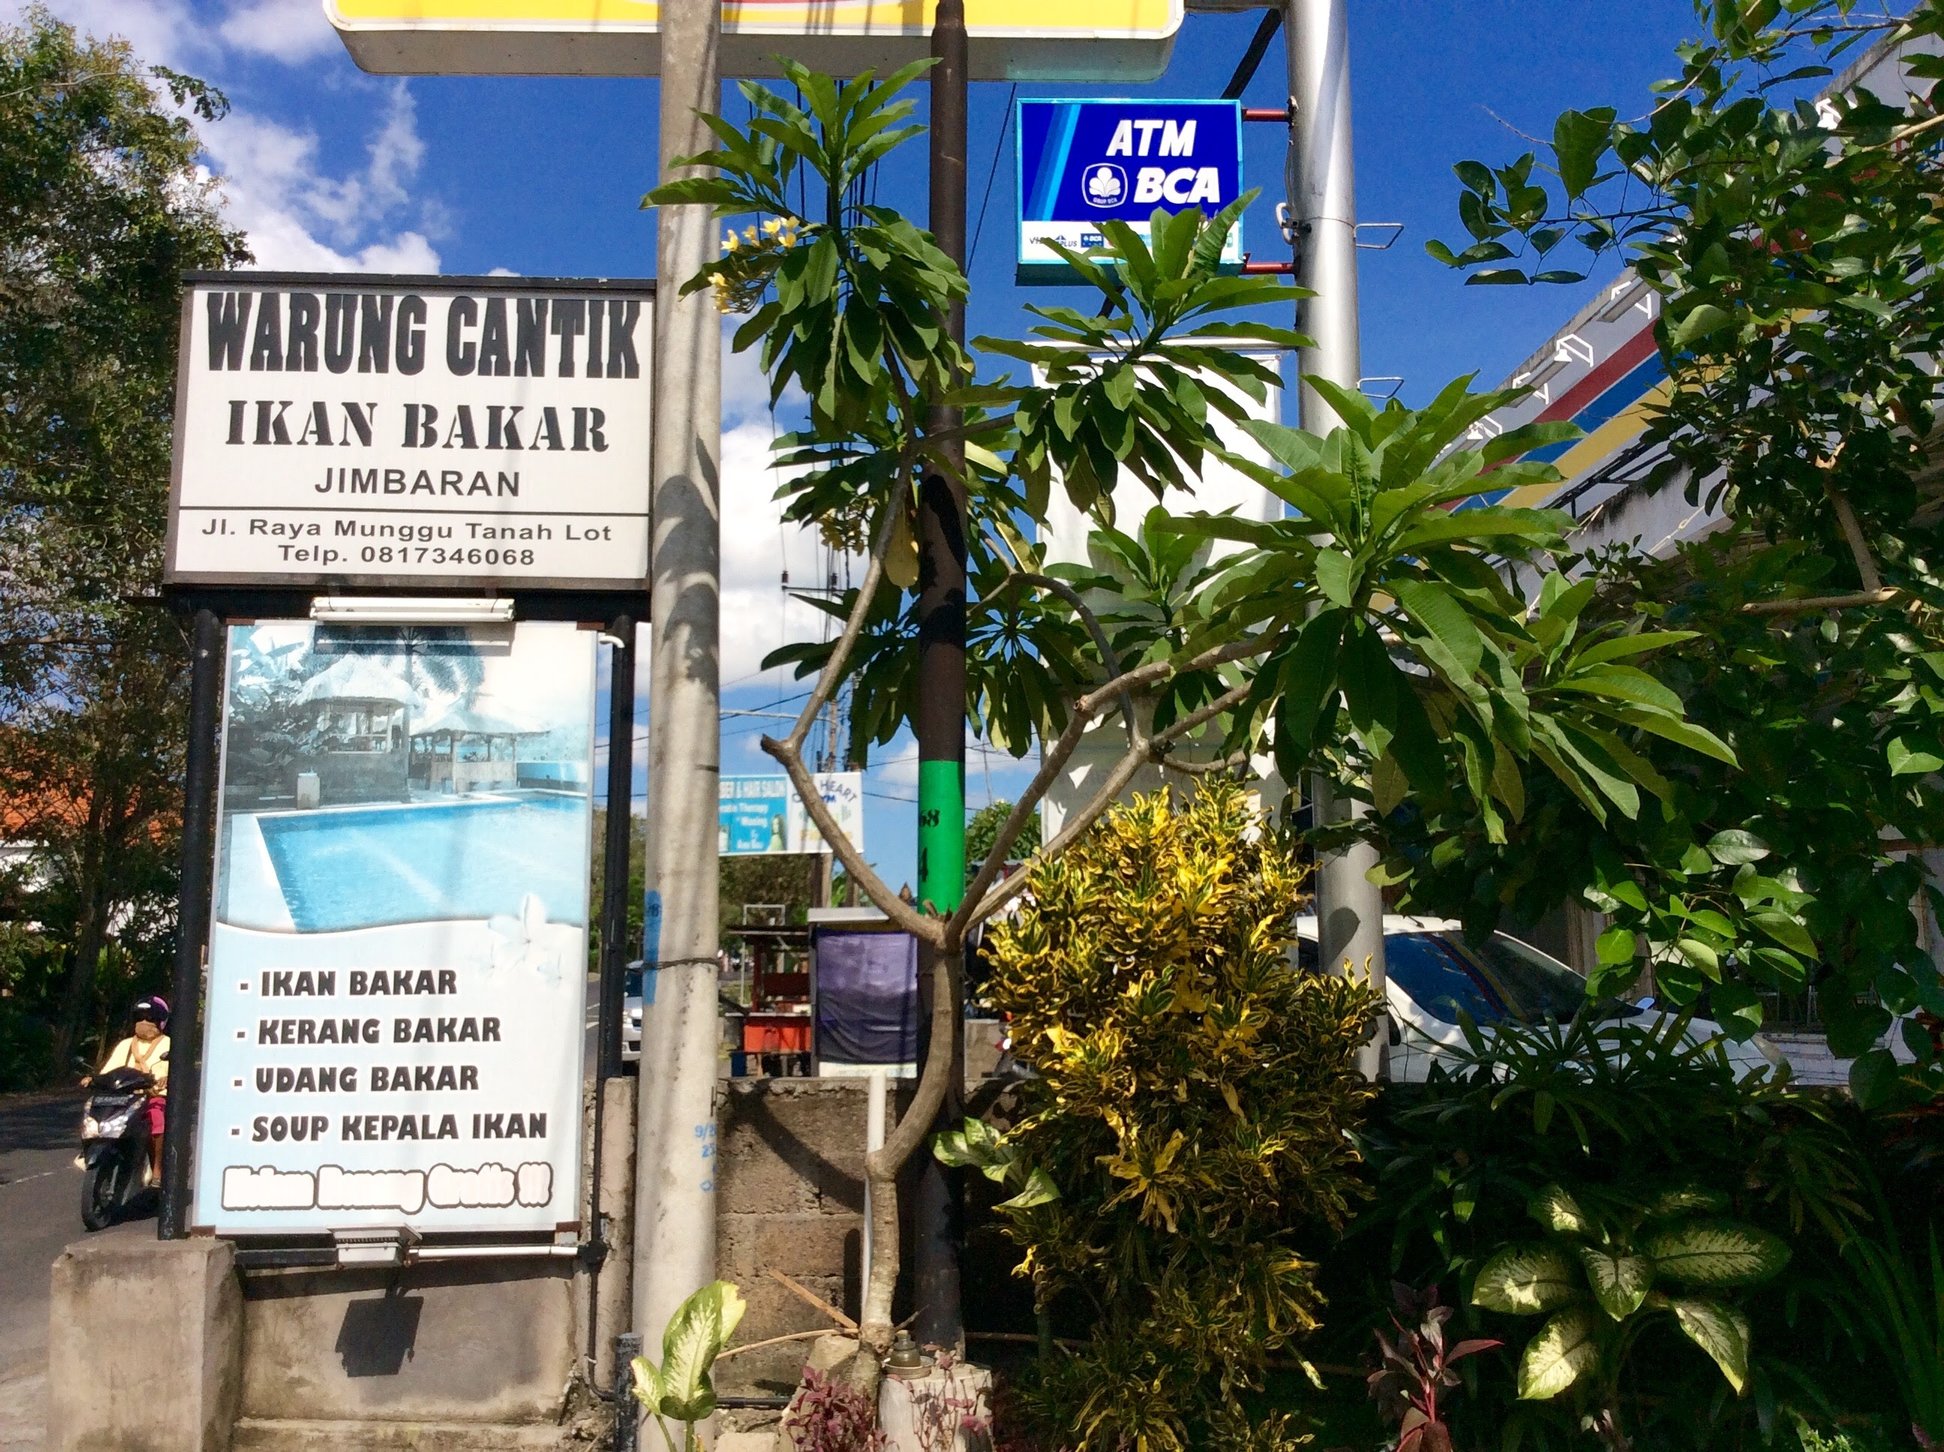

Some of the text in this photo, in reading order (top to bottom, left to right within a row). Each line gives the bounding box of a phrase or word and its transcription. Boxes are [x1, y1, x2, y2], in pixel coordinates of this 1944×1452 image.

[1105, 119, 1198, 157] ATM
[1133, 166, 1221, 204] BCA
[206, 291, 640, 380] WARUNG CANTIK
[225, 400, 609, 452] IKAN BAKAR
[314, 467, 519, 497] JIMBARAN
[249, 519, 321, 539] Raya
[334, 520, 452, 542] Munggu
[465, 522, 552, 540] Tanah
[566, 524, 611, 541] Lot
[278, 544, 535, 566] Telp. 0817346068
[261, 969, 457, 996] IKAN BAKAR
[258, 1016, 501, 1045] KERANG BAKAR
[256, 1065, 479, 1093] UDANG BAKAR
[252, 1113, 547, 1142] SOUP KEPALA IKAN
